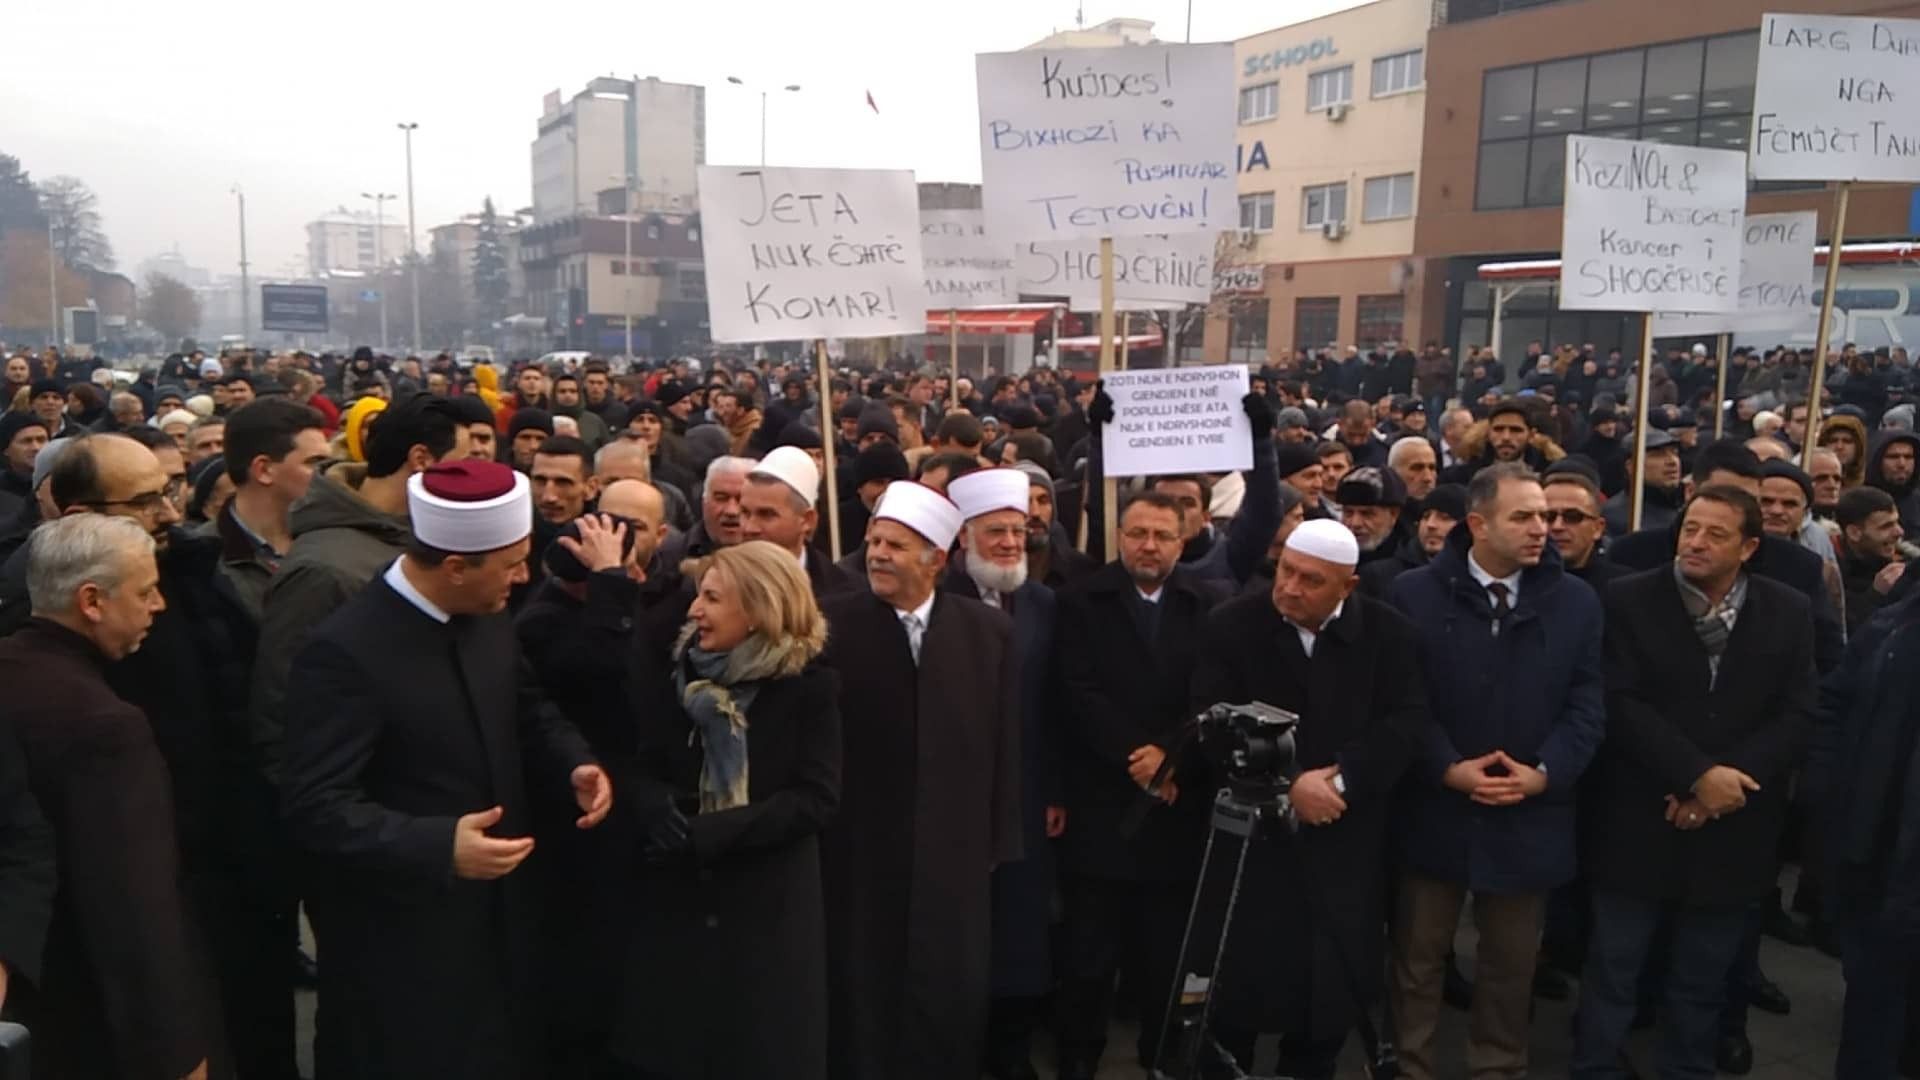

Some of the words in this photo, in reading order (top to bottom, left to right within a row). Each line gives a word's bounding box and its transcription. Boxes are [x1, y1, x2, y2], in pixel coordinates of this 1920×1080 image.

[1768, 18, 1851, 53] LARG
[1243, 36, 1339, 76] SCHOOL
[1838, 77, 1896, 104] NGA
[1142, 121, 1182, 144] KA
[1868, 121, 1920, 157] TAN
[1236, 140, 1271, 173] IA
[737, 170, 859, 227] JETA
[751, 242, 822, 271] NUK
[744, 281, 899, 324] KOMAR!
[1109, 375, 1135, 387] ZOTI
[1137, 374, 1162, 385] NUK
[1165, 373, 1172, 384] E
[1175, 370, 1240, 383] NDRYSHON
[1189, 387, 1196, 398] E
[1174, 402, 1201, 415] NËSE
[1205, 402, 1230, 413] ATA
[1120, 422, 1145, 433] NUK
[1148, 421, 1155, 431] E
[1187, 435, 1194, 445] E
[1197, 433, 1224, 445] TYRE
